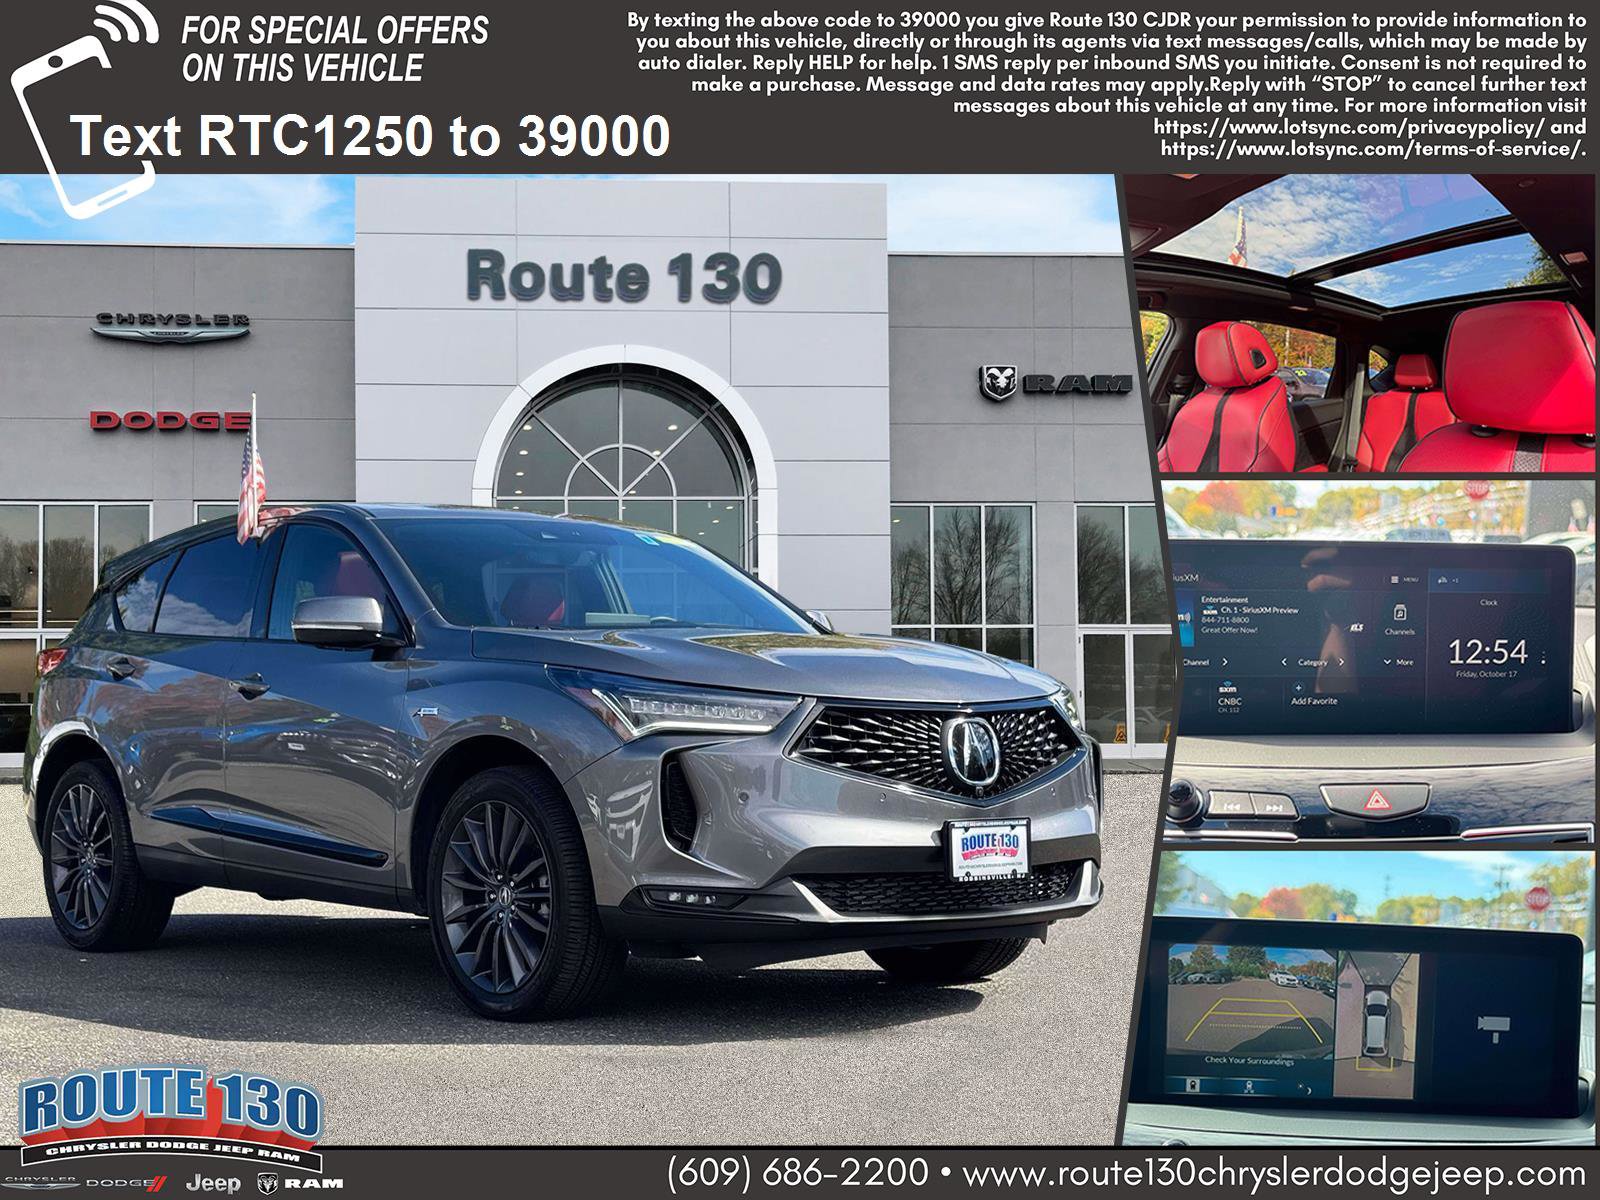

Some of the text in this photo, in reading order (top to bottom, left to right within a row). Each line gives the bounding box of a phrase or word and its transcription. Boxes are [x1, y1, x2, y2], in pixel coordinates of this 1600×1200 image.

[466, 249, 783, 304] Route 130
[96, 312, 250, 326] CHRYSLER
[1023, 374, 1133, 394] RAM
[89, 411, 252, 432] DODGE
[1201, 596, 1249, 604] Entertainment
[1480, 599, 1498, 607] Clock
[1221, 606, 1232, 614] Ch.
[1242, 606, 1271, 614] SiriusXM
[1201, 626, 1220, 634] Great
[1221, 626, 1239, 634] Offer
[1384, 627, 1416, 635] Channels
[1449, 639, 1528, 665] 12:54
[1183, 658, 1210, 666] Channel
[1298, 659, 1328, 668] Category
[1456, 670, 1518, 679] Friday, October 17
[1218, 697, 1242, 706] CNBC
[1291, 697, 1338, 706] Add Favorite
[961, 834, 1019, 852] ROUTE 130
[1205, 1056, 1295, 1067] Check Your Surroundings
